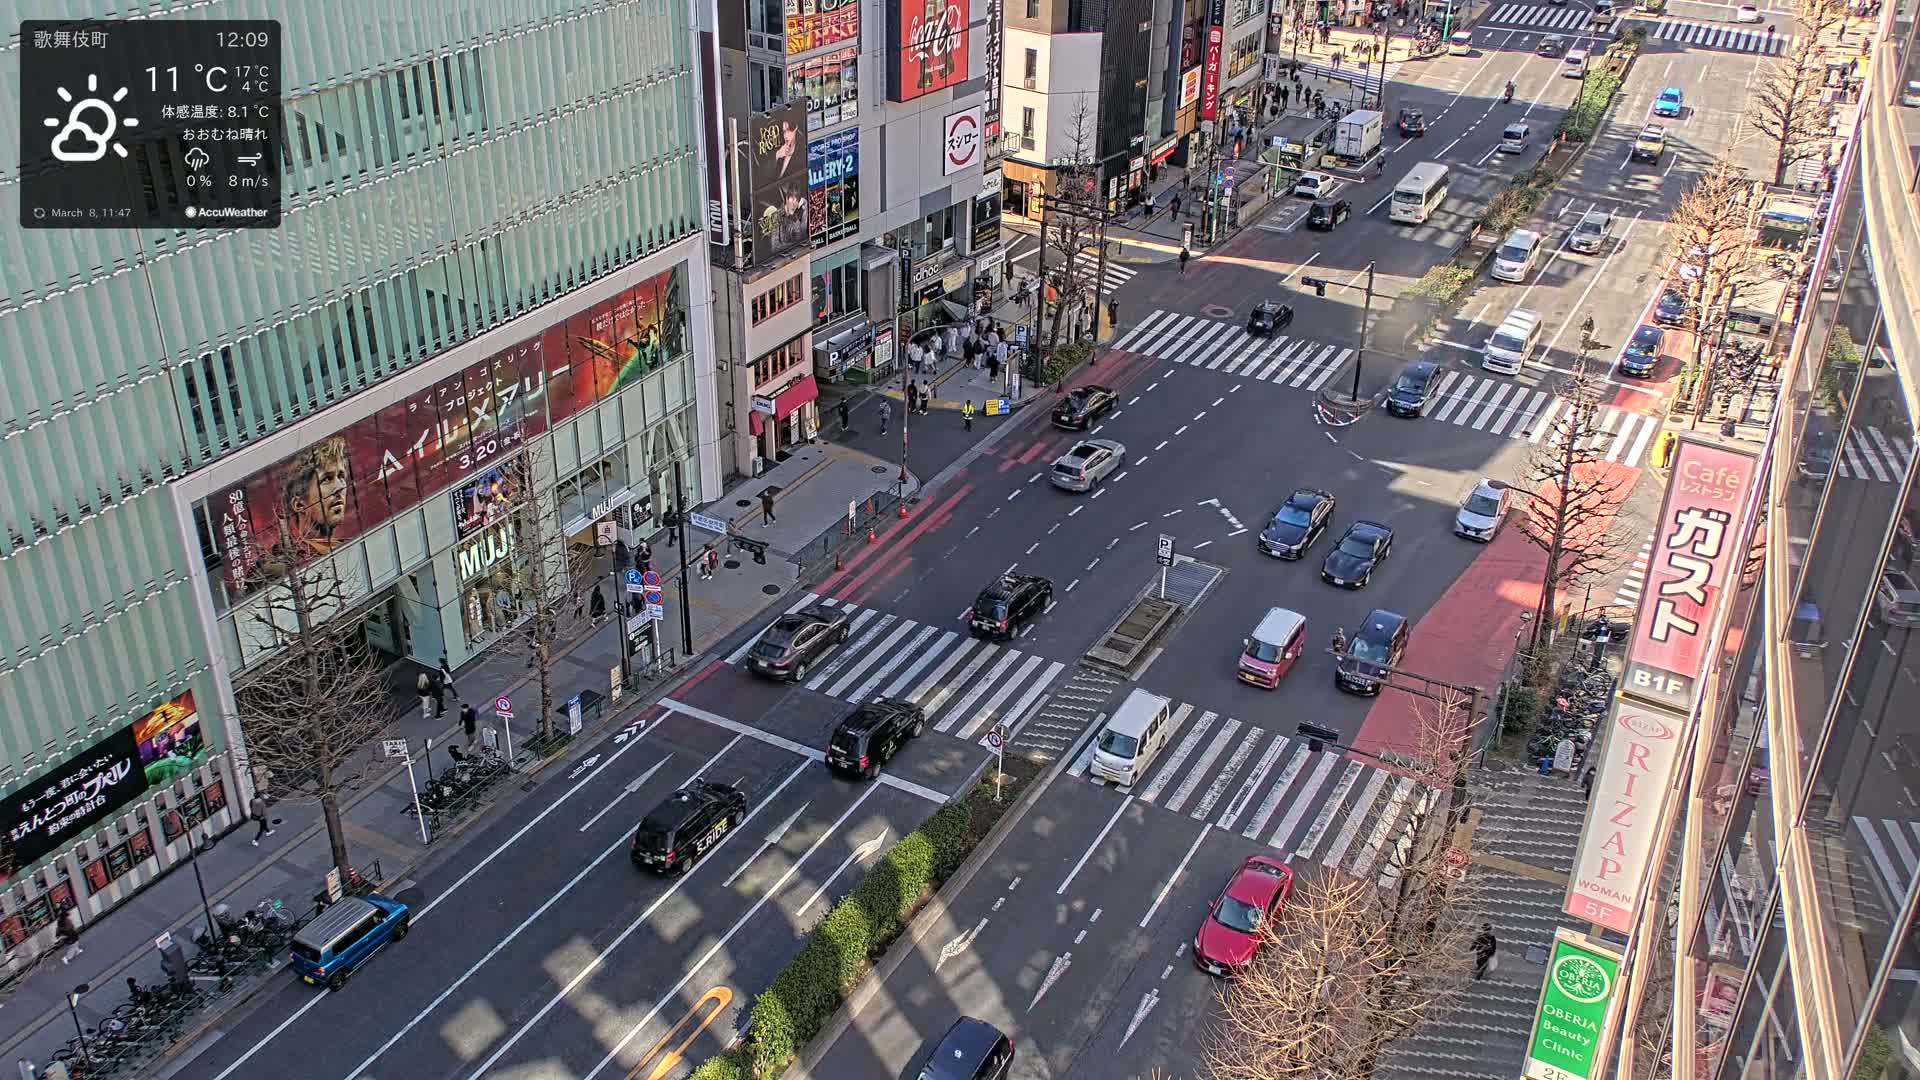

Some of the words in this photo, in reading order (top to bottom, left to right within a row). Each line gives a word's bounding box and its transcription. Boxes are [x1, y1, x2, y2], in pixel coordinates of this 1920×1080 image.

[1206, 46, 1220, 110] バーガーキング
[947, 132, 979, 152] スシロー
[710, 199, 723, 232] MUJI
[829, 224, 857, 239] BASKETBALL
[902, 249, 909, 259] P
[1017, 325, 1025, 335] P
[829, 351, 839, 366] P
[409, 341, 541, 412] ライアン・ゴズリング
[446, 377, 502, 411] プロジェクト
[458, 440, 497, 470] 3.20
[1682, 460, 1741, 490] Café
[1680, 480, 1736, 503] レストラン
[592, 496, 615, 520] MUJI
[458, 523, 517, 581] MUJI
[1161, 539, 1169, 549] P
[1649, 508, 1732, 642] ガスト
[1633, 669, 1684, 695] B1F
[1596, 740, 1652, 882] RIZAP
[1578, 879, 1633, 905] WOMAN
[1584, 899, 1615, 921] 5F
[1558, 968, 1602, 993] OBERIA
[1542, 1003, 1599, 1033] OBERIA
[1543, 1019, 1591, 1048] Beauty
[1541, 1038, 1584, 1062] Clinic
